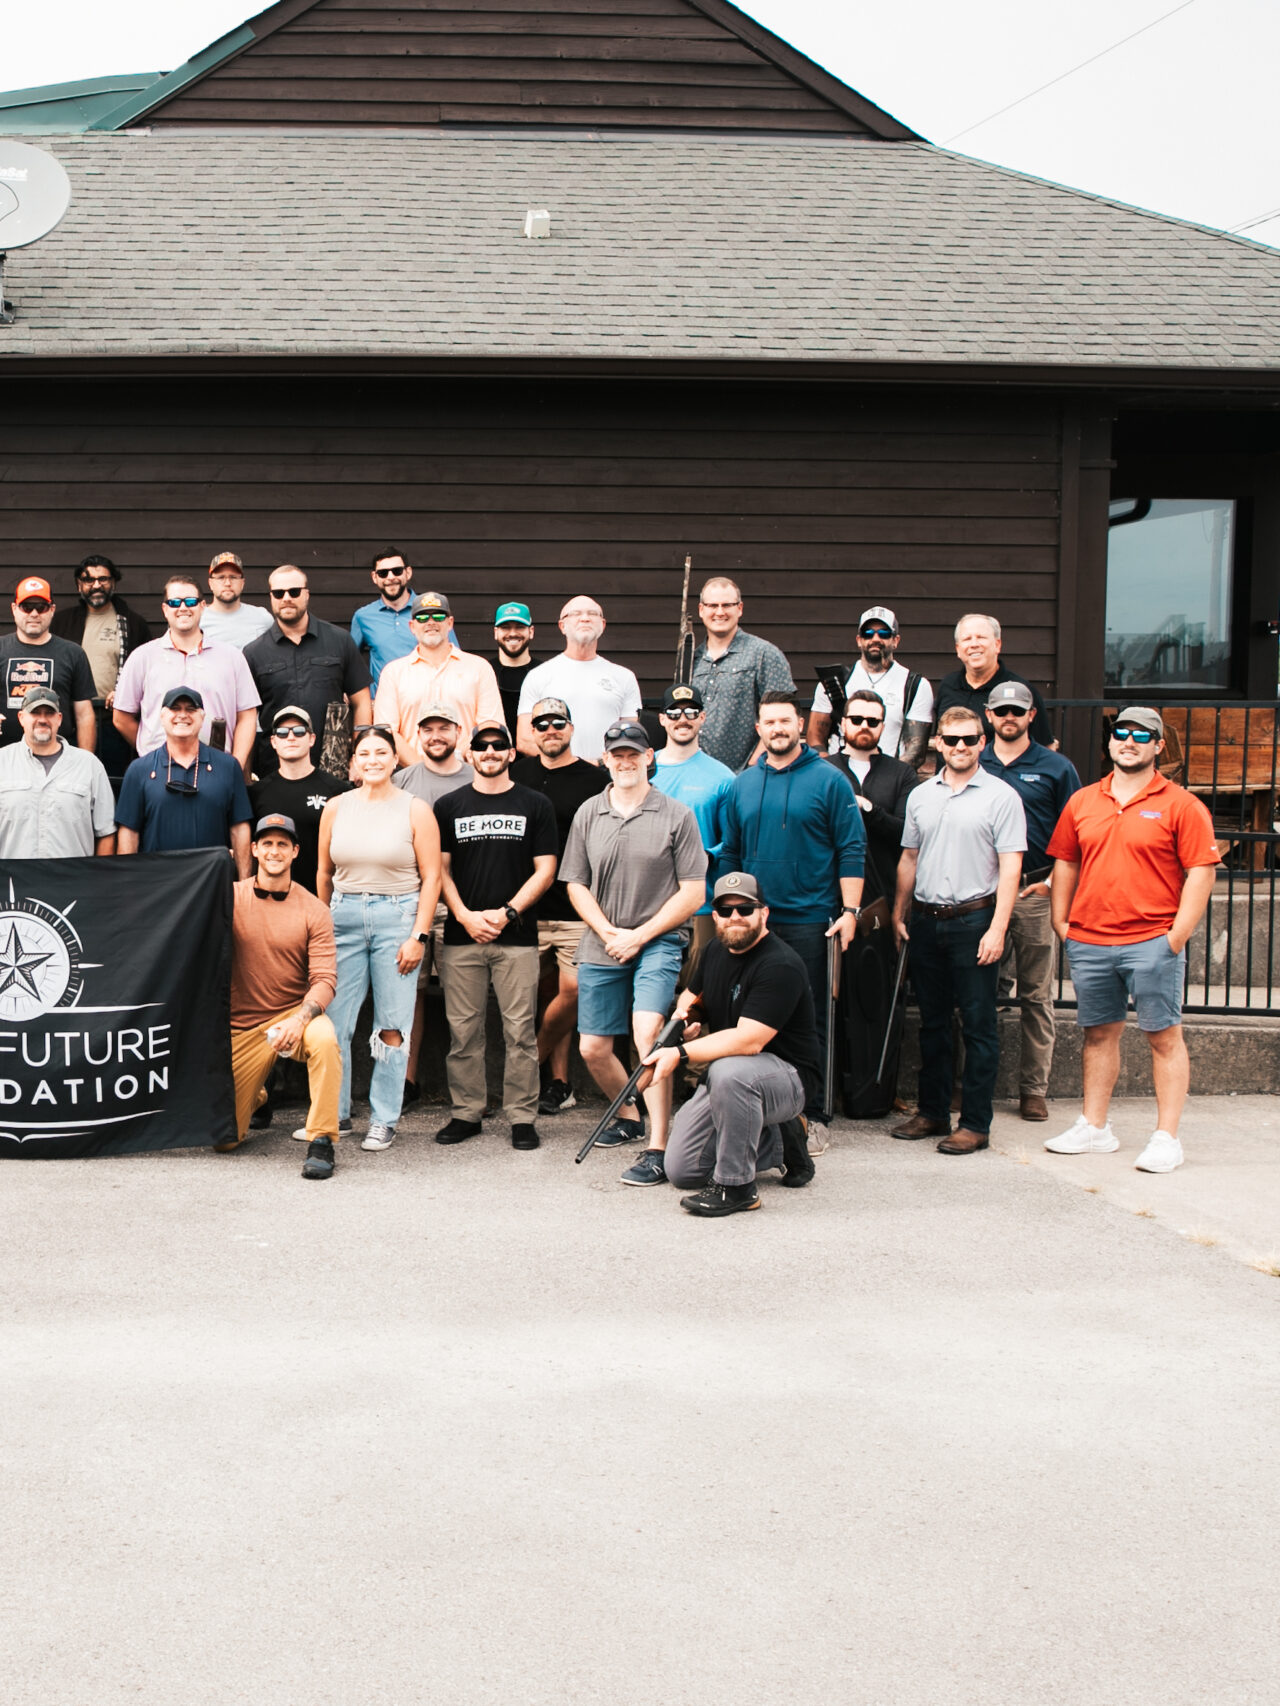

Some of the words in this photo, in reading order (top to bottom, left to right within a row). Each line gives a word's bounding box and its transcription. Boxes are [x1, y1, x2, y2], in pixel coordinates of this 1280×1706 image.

[11, 683, 41, 697] KT
[459, 820, 476, 834] BE
[481, 819, 523, 831] MORE
